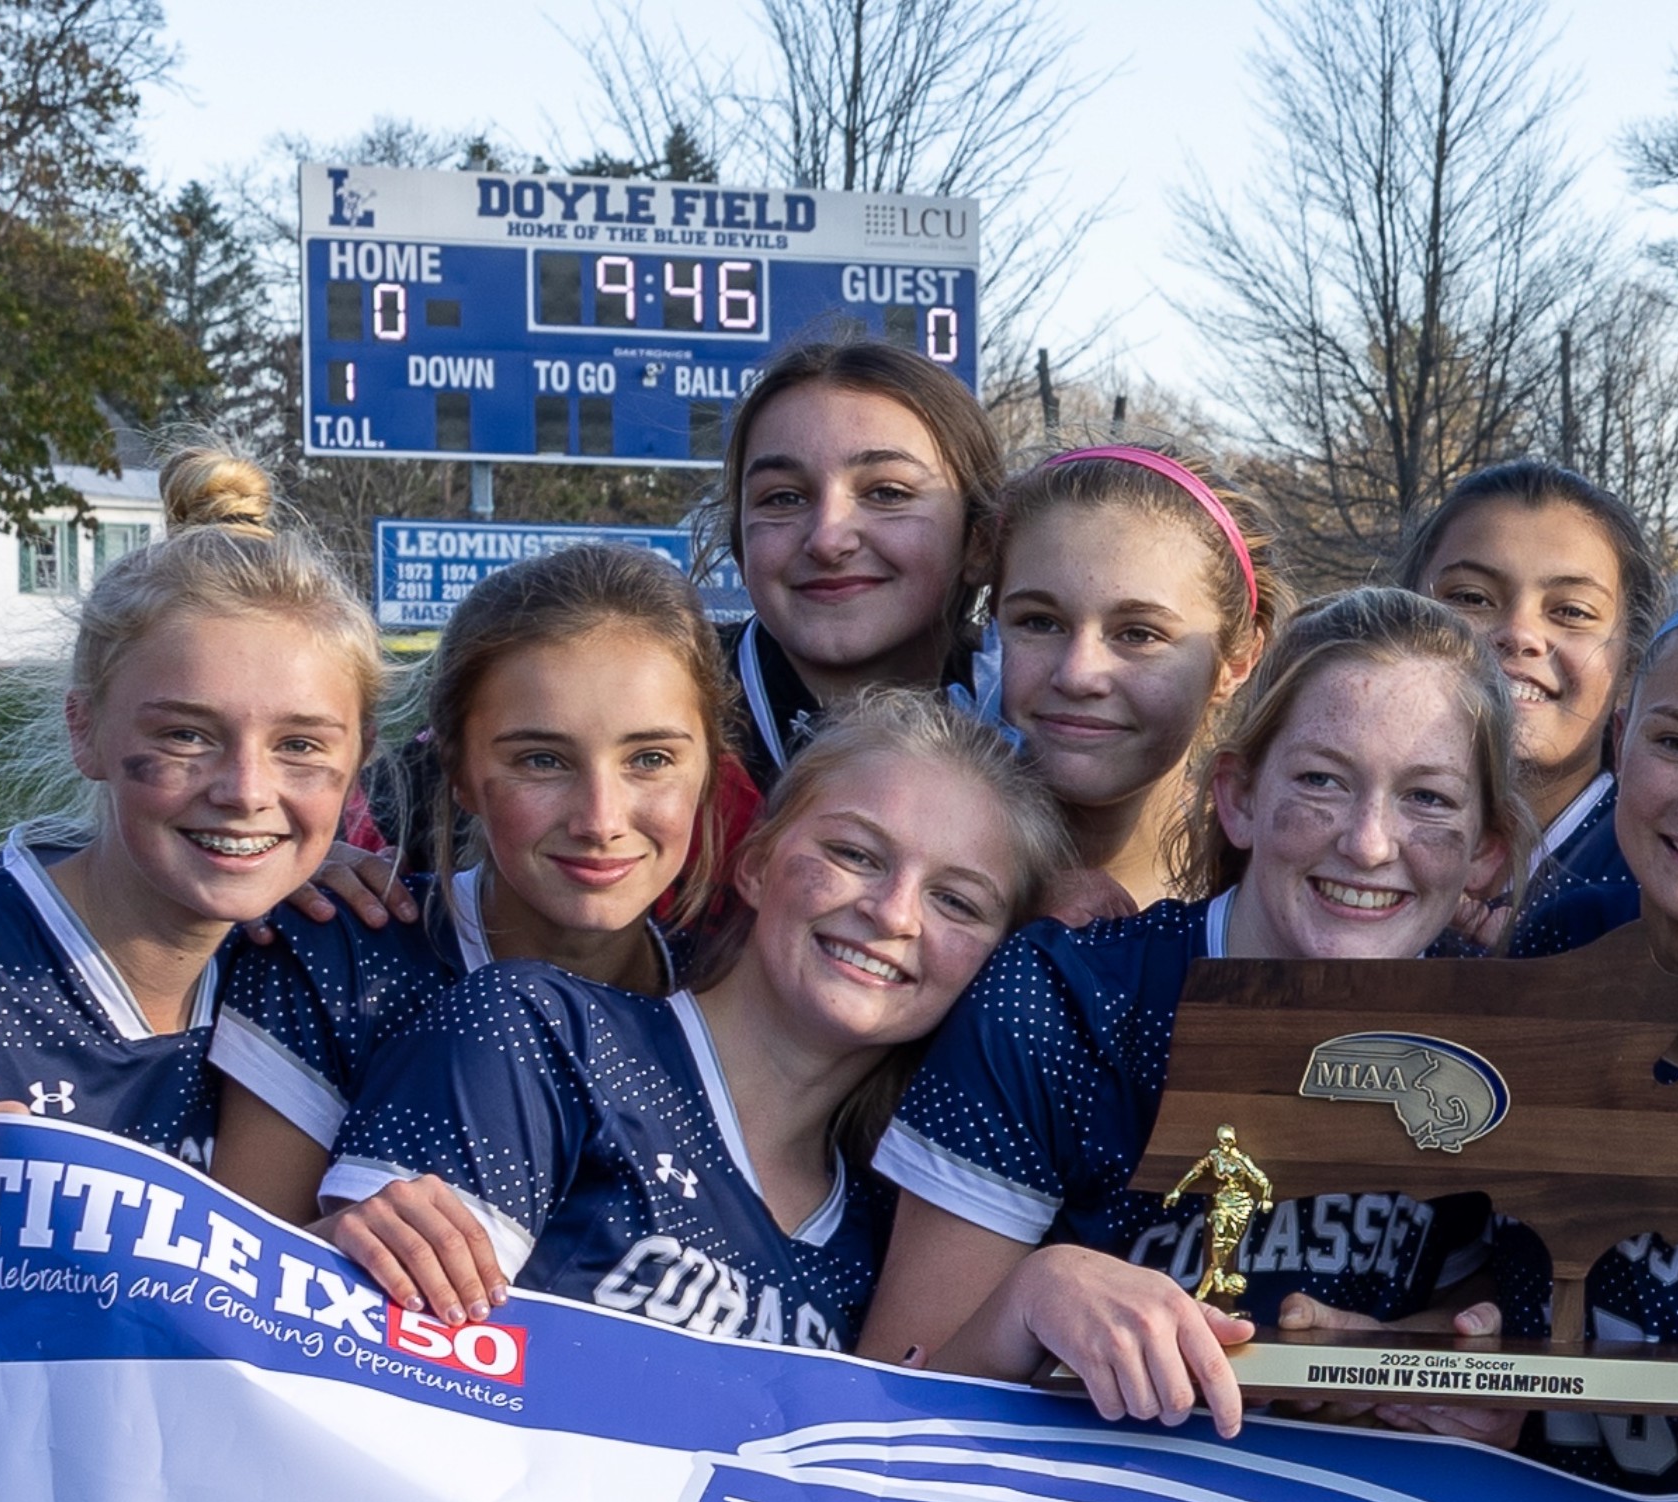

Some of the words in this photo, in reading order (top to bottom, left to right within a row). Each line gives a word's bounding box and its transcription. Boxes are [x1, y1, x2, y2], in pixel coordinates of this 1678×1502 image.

[477, 178, 655, 224] DOYLE
[671, 188, 816, 233] FIELD
[507, 221, 567, 238] HOME
[575, 225, 598, 240] OF
[606, 226, 647, 243] THE
[654, 228, 707, 246] BLUE
[712, 230, 788, 250] DEVILS
[900, 207, 966, 239] LCU
[329, 241, 442, 283] HOME
[596, 255, 756, 329] 9:46
[841, 265, 961, 306] GUEST
[374, 283, 405, 341] 0
[926, 307, 957, 363] 0
[408, 355, 494, 390] DOWN
[533, 360, 570, 391] TO
[577, 362, 616, 394] GO
[675, 365, 736, 397] BALL
[315, 415, 385, 448] T.O.L.
[396, 530, 601, 558] LEOMINS
[397, 563, 432, 581] 1973
[441, 564, 476, 582] 1974
[396, 582, 431, 600] 2011
[1315, 1062, 1407, 1092] MIAA
[274, 1254, 383, 1344] IX
[396, 1310, 520, 1376] 50
[128, 1277, 194, 1305] and
[206, 1286, 324, 1359] Growing
[334, 1334, 525, 1412] Opportunities
[1380, 1353, 1420, 1367] 2022
[1425, 1355, 1462, 1369] Girls'
[1465, 1357, 1516, 1372] Soccer
[1307, 1365, 1389, 1385] DIVISION
[1394, 1368, 1414, 1386] IV
[1417, 1370, 1472, 1389] STATE
[1475, 1372, 1584, 1395] CHAMPIONS
